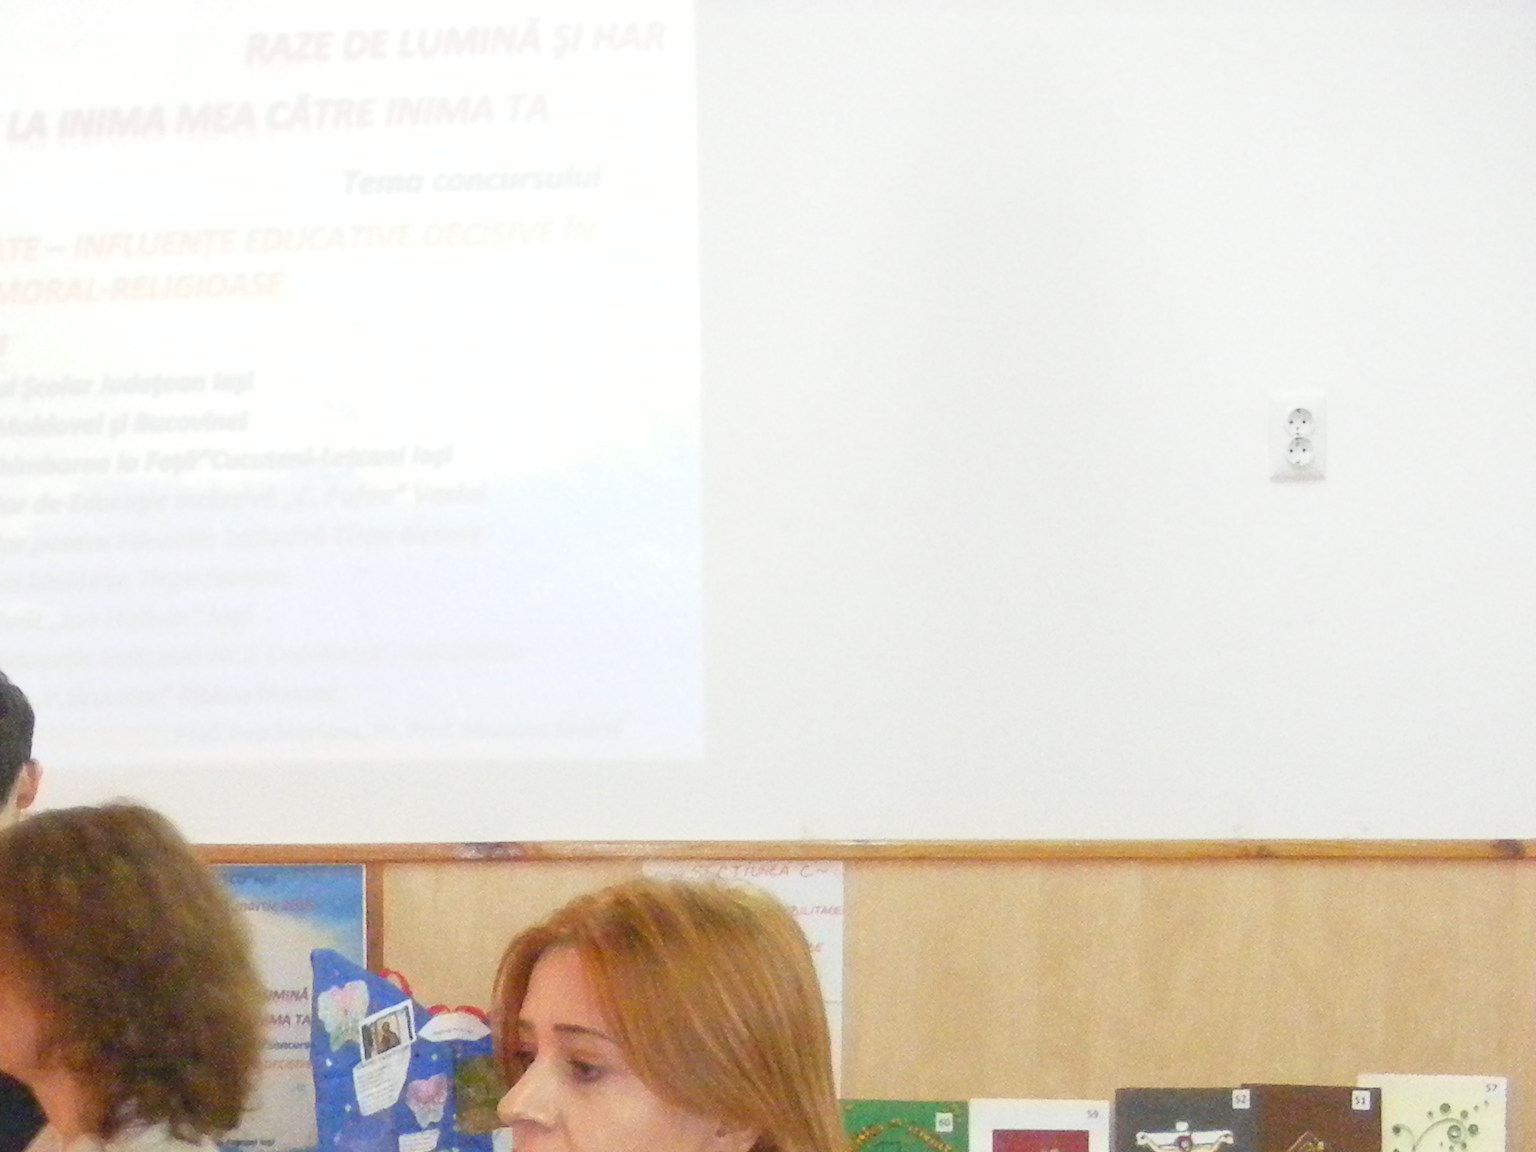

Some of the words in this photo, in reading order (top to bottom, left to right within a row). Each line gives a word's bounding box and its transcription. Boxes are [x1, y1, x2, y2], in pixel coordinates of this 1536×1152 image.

[245, 31, 334, 66] RAZE
[342, 28, 390, 61] DE
[397, 18, 542, 60] LUMINĂ
[592, 21, 666, 53] HAR
[7, 109, 48, 143] LA
[58, 105, 166, 139] INIMA
[174, 101, 256, 136] MEA
[265, 91, 378, 131] CĂTRE
[385, 94, 494, 129] INIMA
[509, 93, 552, 124] TA
[342, 168, 424, 196] Tema
[432, 162, 602, 194] concursului
[244, 222, 413, 253] EDUCATIVE
